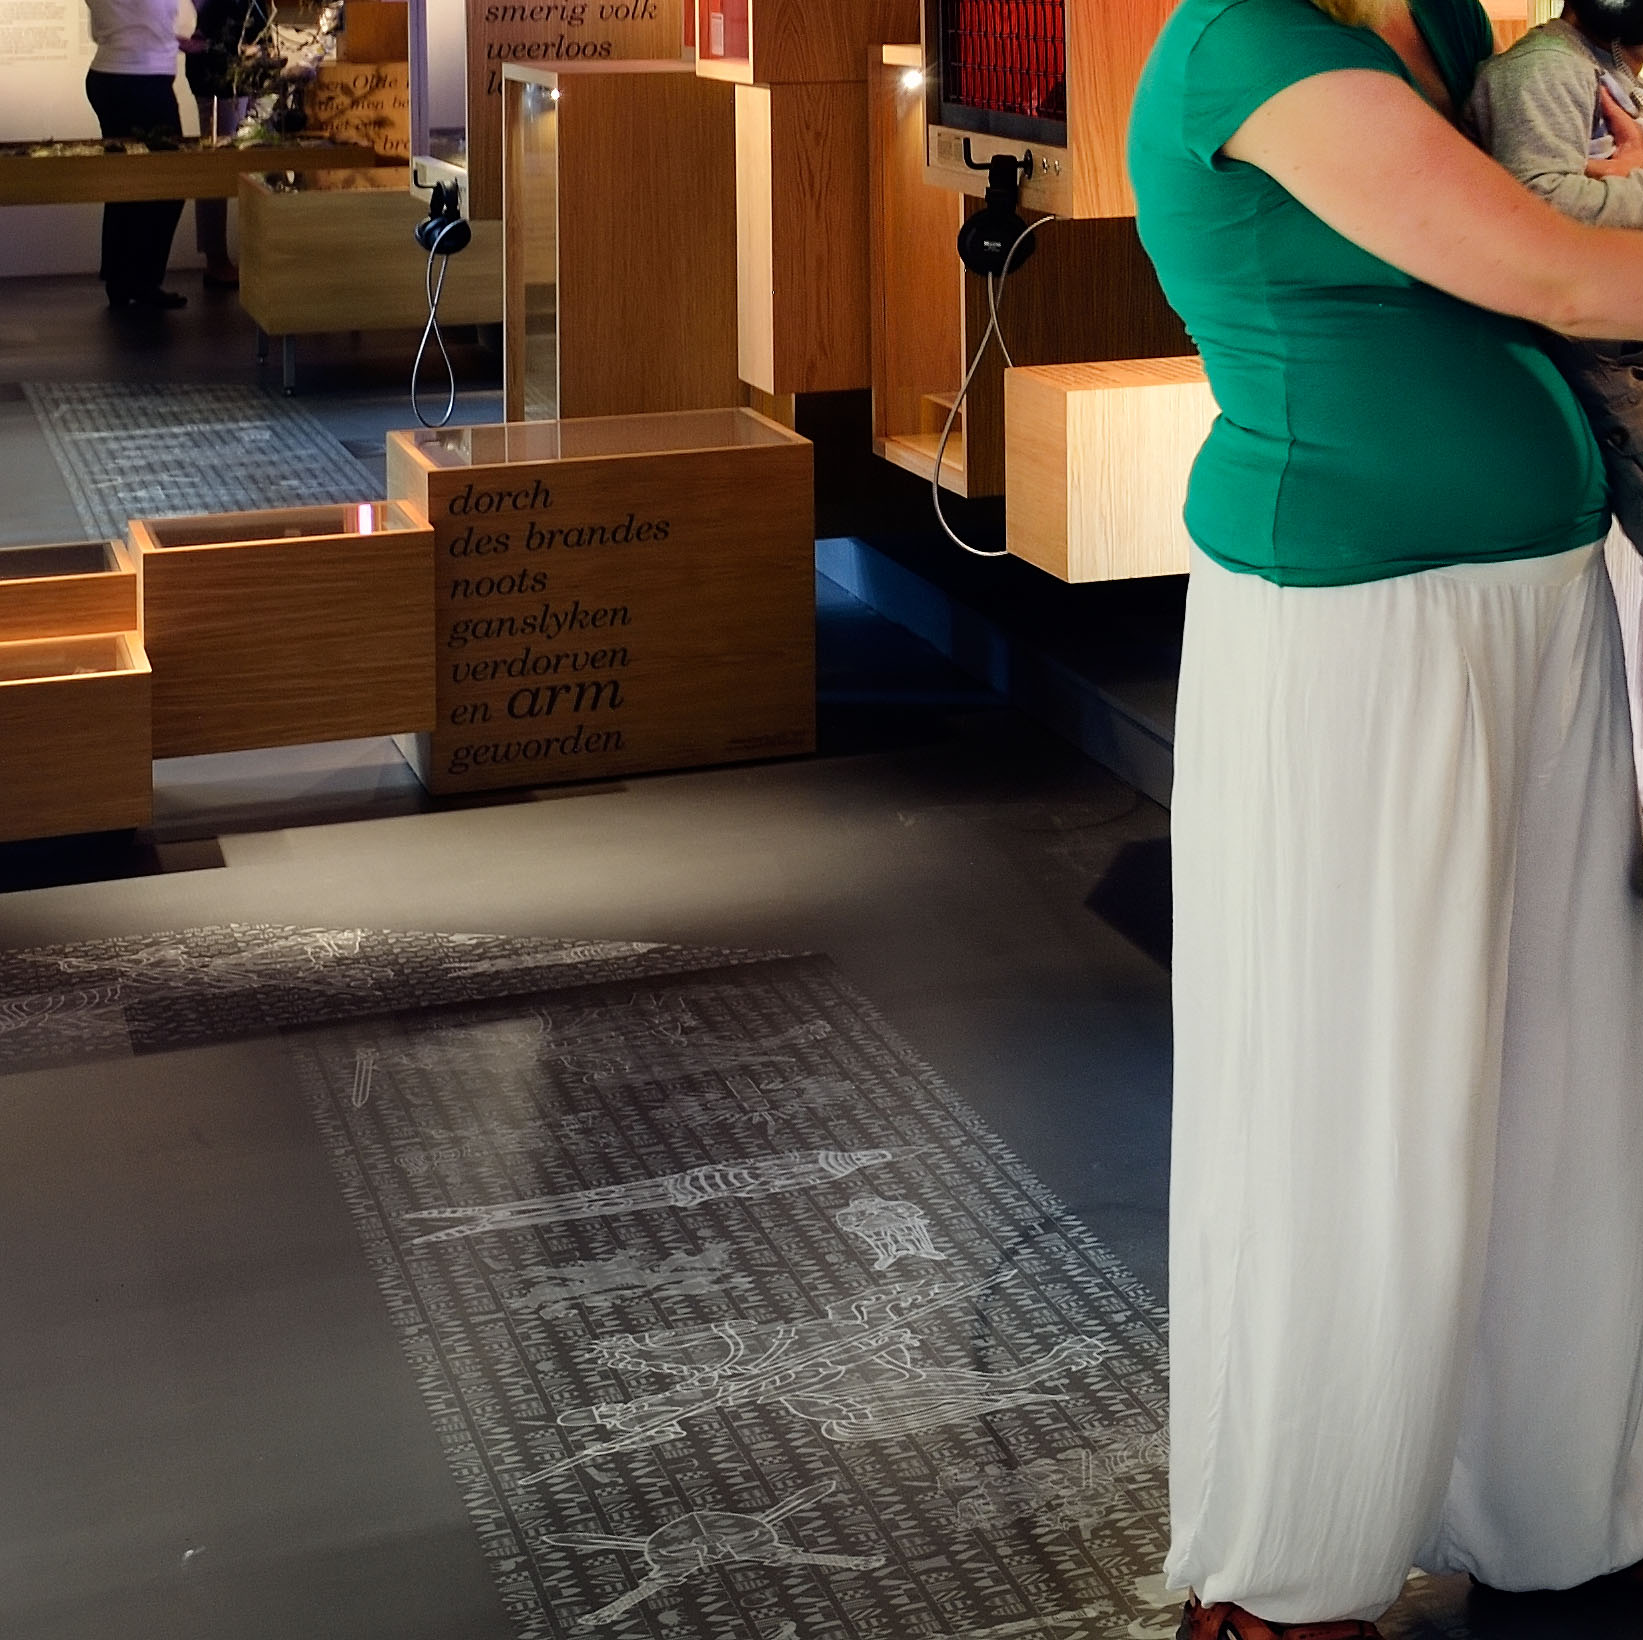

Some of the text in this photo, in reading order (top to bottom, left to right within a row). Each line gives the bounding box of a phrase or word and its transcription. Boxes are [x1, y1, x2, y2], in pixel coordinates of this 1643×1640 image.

[486, 34, 612, 59] weerloos
[449, 479, 553, 515] dorch
[450, 513, 670, 558] des brandes
[451, 568, 548, 600] noots
[448, 600, 631, 649] ganslyken
[452, 647, 630, 683] verdorven
[451, 679, 624, 725] en arm
[448, 724, 625, 775] geworden
